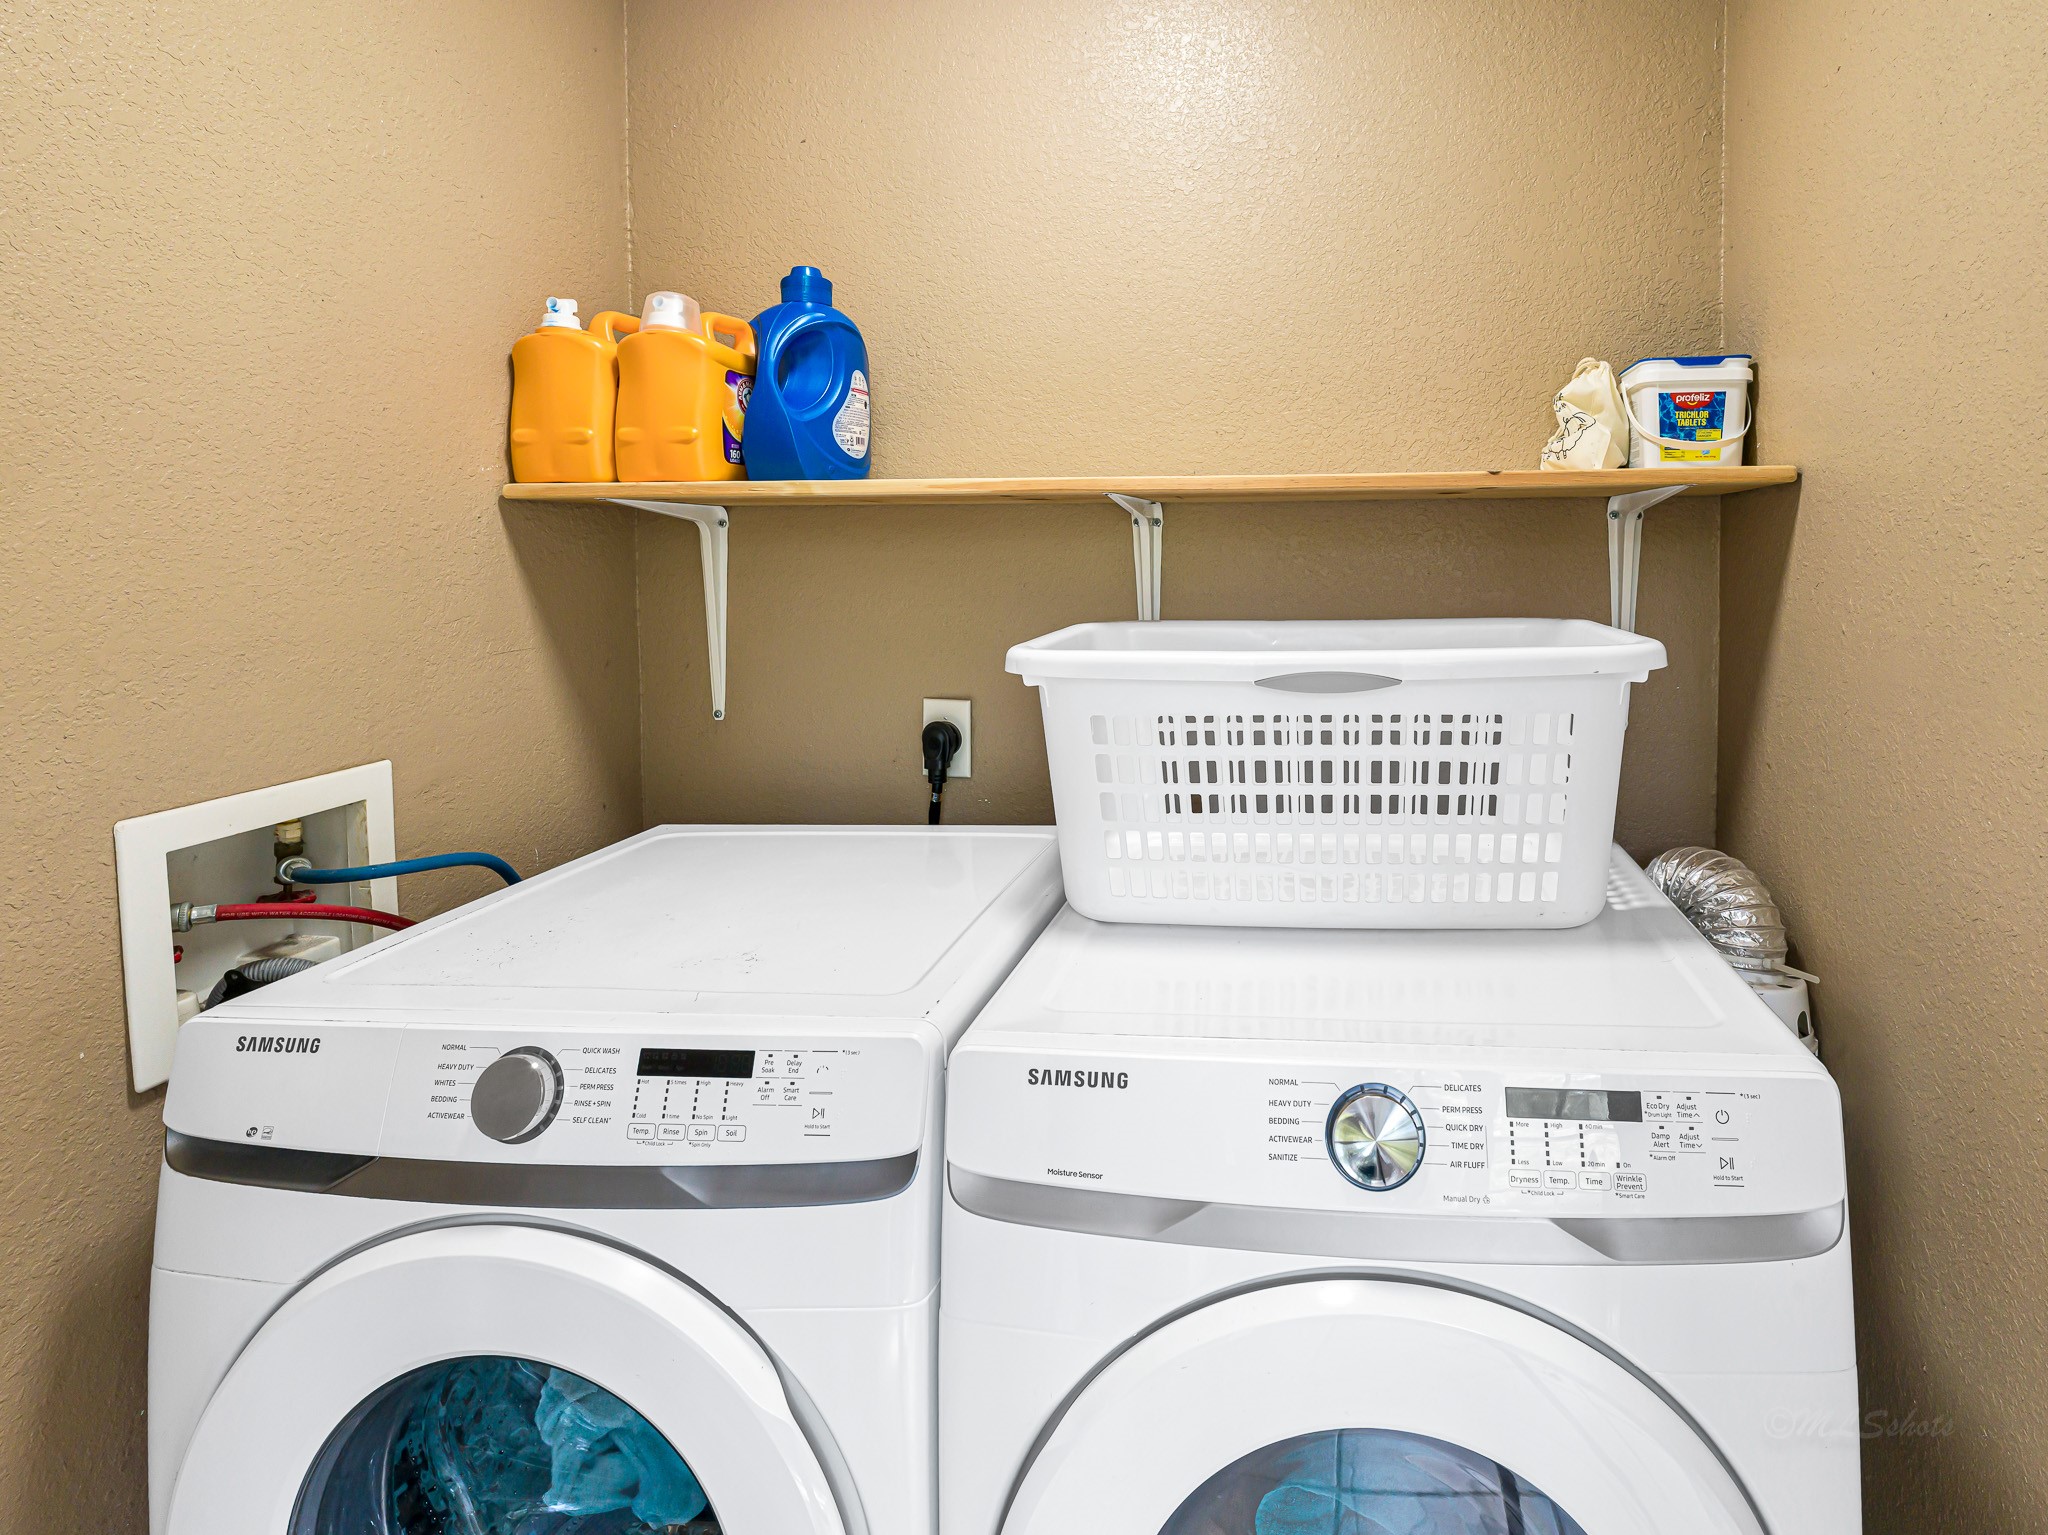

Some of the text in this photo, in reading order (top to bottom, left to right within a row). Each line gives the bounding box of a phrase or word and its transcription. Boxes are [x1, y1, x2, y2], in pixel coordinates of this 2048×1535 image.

[1676, 393, 1711, 403] profeliz
[1675, 410, 1709, 419] TRICHLOR
[1677, 418, 1707, 427] TABLETS
[730, 449, 741, 458] 160
[236, 1036, 321, 1054] SAMSUNG
[602, 1047, 621, 1055] WASH
[584, 1067, 617, 1075] DELICATES
[1028, 1068, 1129, 1089] SAMSUNG
[1268, 1078, 1298, 1086] NORMAL
[434, 1079, 456, 1087] WHITES
[1444, 1084, 1482, 1092] DELICATES
[430, 1095, 458, 1103] BEDDING
[1292, 1100, 1312, 1108] DUTY
[1658, 1103, 1670, 1111] Dry
[1676, 1103, 1697, 1111] Adjust
[1462, 1106, 1483, 1114] PRESS
[427, 1111, 465, 1120] ACTIVEWEAR
[572, 1116, 587, 1124] SELF
[1268, 1117, 1300, 1125] BEDDING
[1445, 1123, 1484, 1132] QUICK DRY
[632, 1128, 651, 1136] Temp.
[662, 1128, 680, 1136] Rinse
[694, 1129, 708, 1137] Spin
[725, 1129, 738, 1137] Soil
[1268, 1135, 1313, 1144] ACTIVEWEAR
[1651, 1133, 1671, 1141] Damp
[1679, 1133, 1700, 1141] Adjust
[1451, 1142, 1485, 1150] TIME DRY
[1268, 1153, 1298, 1161] SANITIZE
[1449, 1160, 1486, 1169] AIR FLUFF
[1047, 1168, 1103, 1180] Moisture Sensor
[1510, 1175, 1539, 1184] Dryness
[1549, 1176, 1570, 1185] Temp.
[1443, 1195, 1481, 1204] Manual Dry
